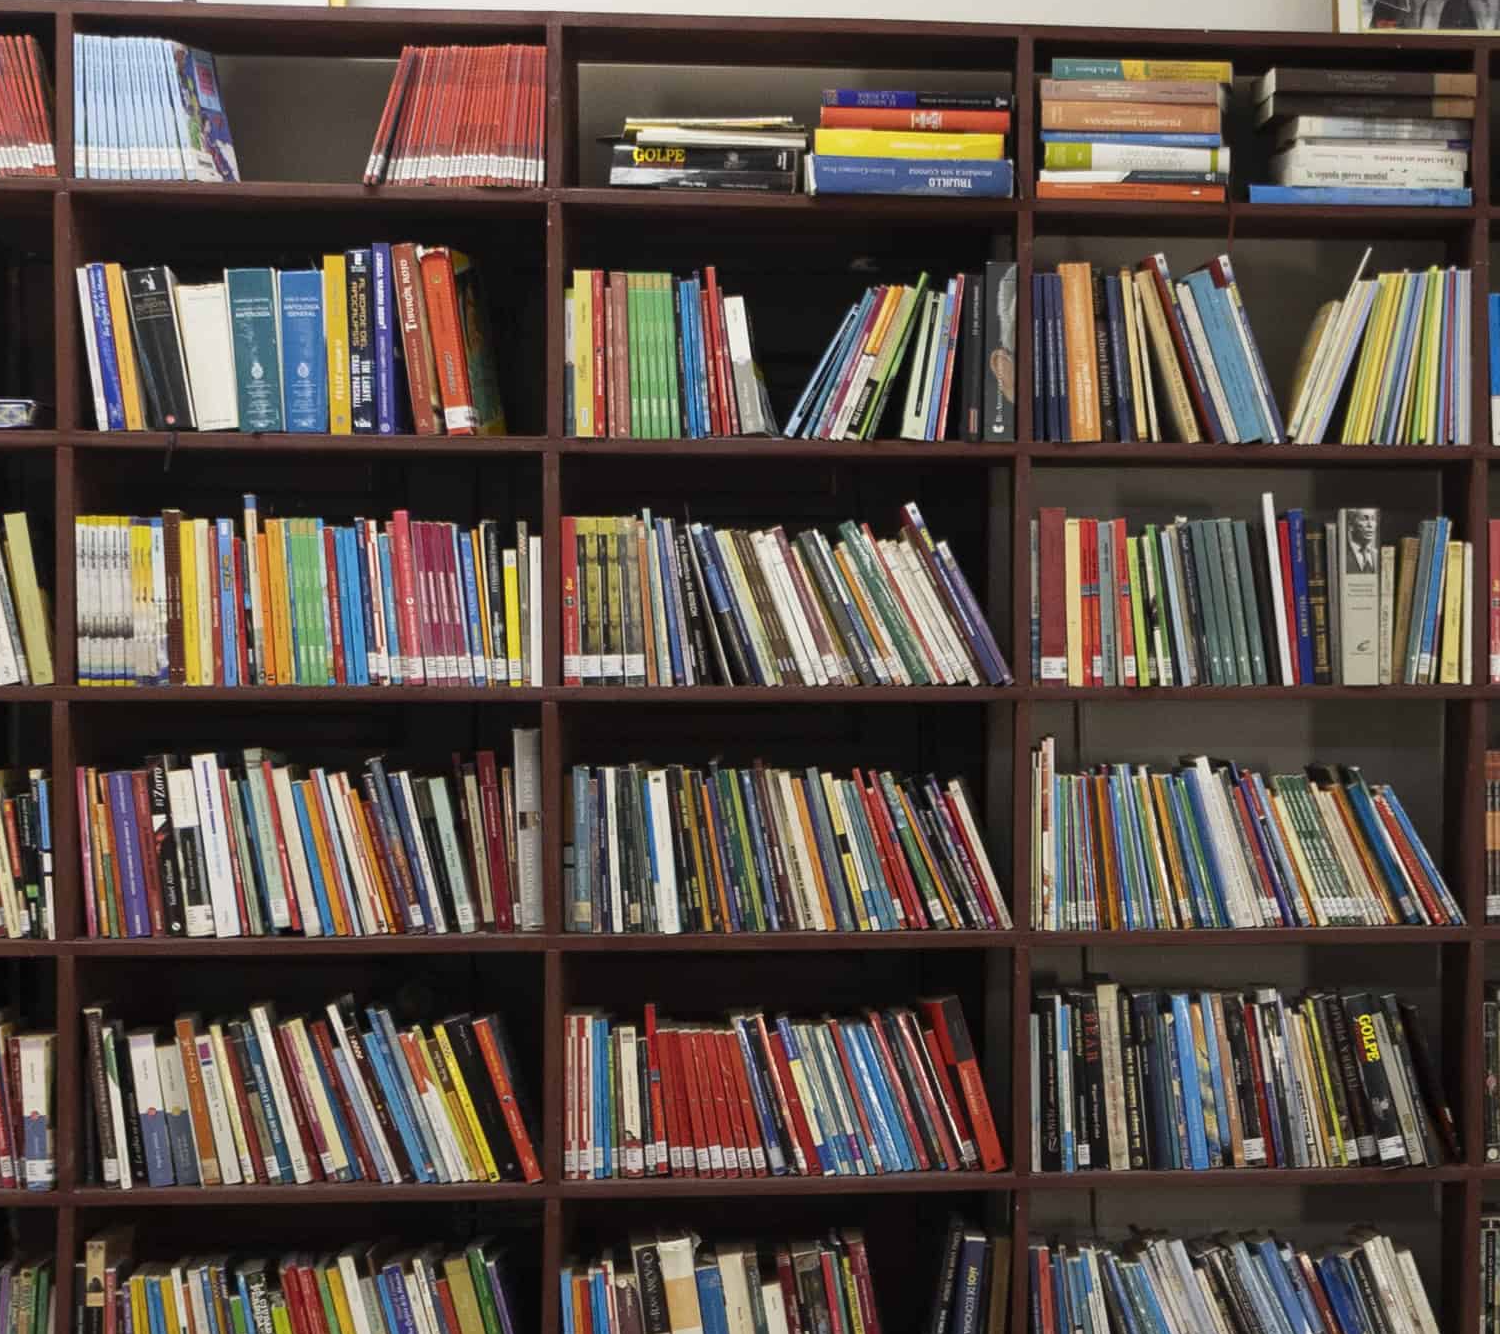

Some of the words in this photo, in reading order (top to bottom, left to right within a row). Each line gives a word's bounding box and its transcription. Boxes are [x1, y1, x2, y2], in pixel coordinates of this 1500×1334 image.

[632, 146, 687, 164] GOLPE
[928, 177, 973, 189] TRUJILLO
[1098, 329, 1109, 360] Albert
[1099, 364, 1112, 406] Einstein
[153, 768, 166, 797] Zorro
[1358, 1013, 1381, 1062] GOLPE
